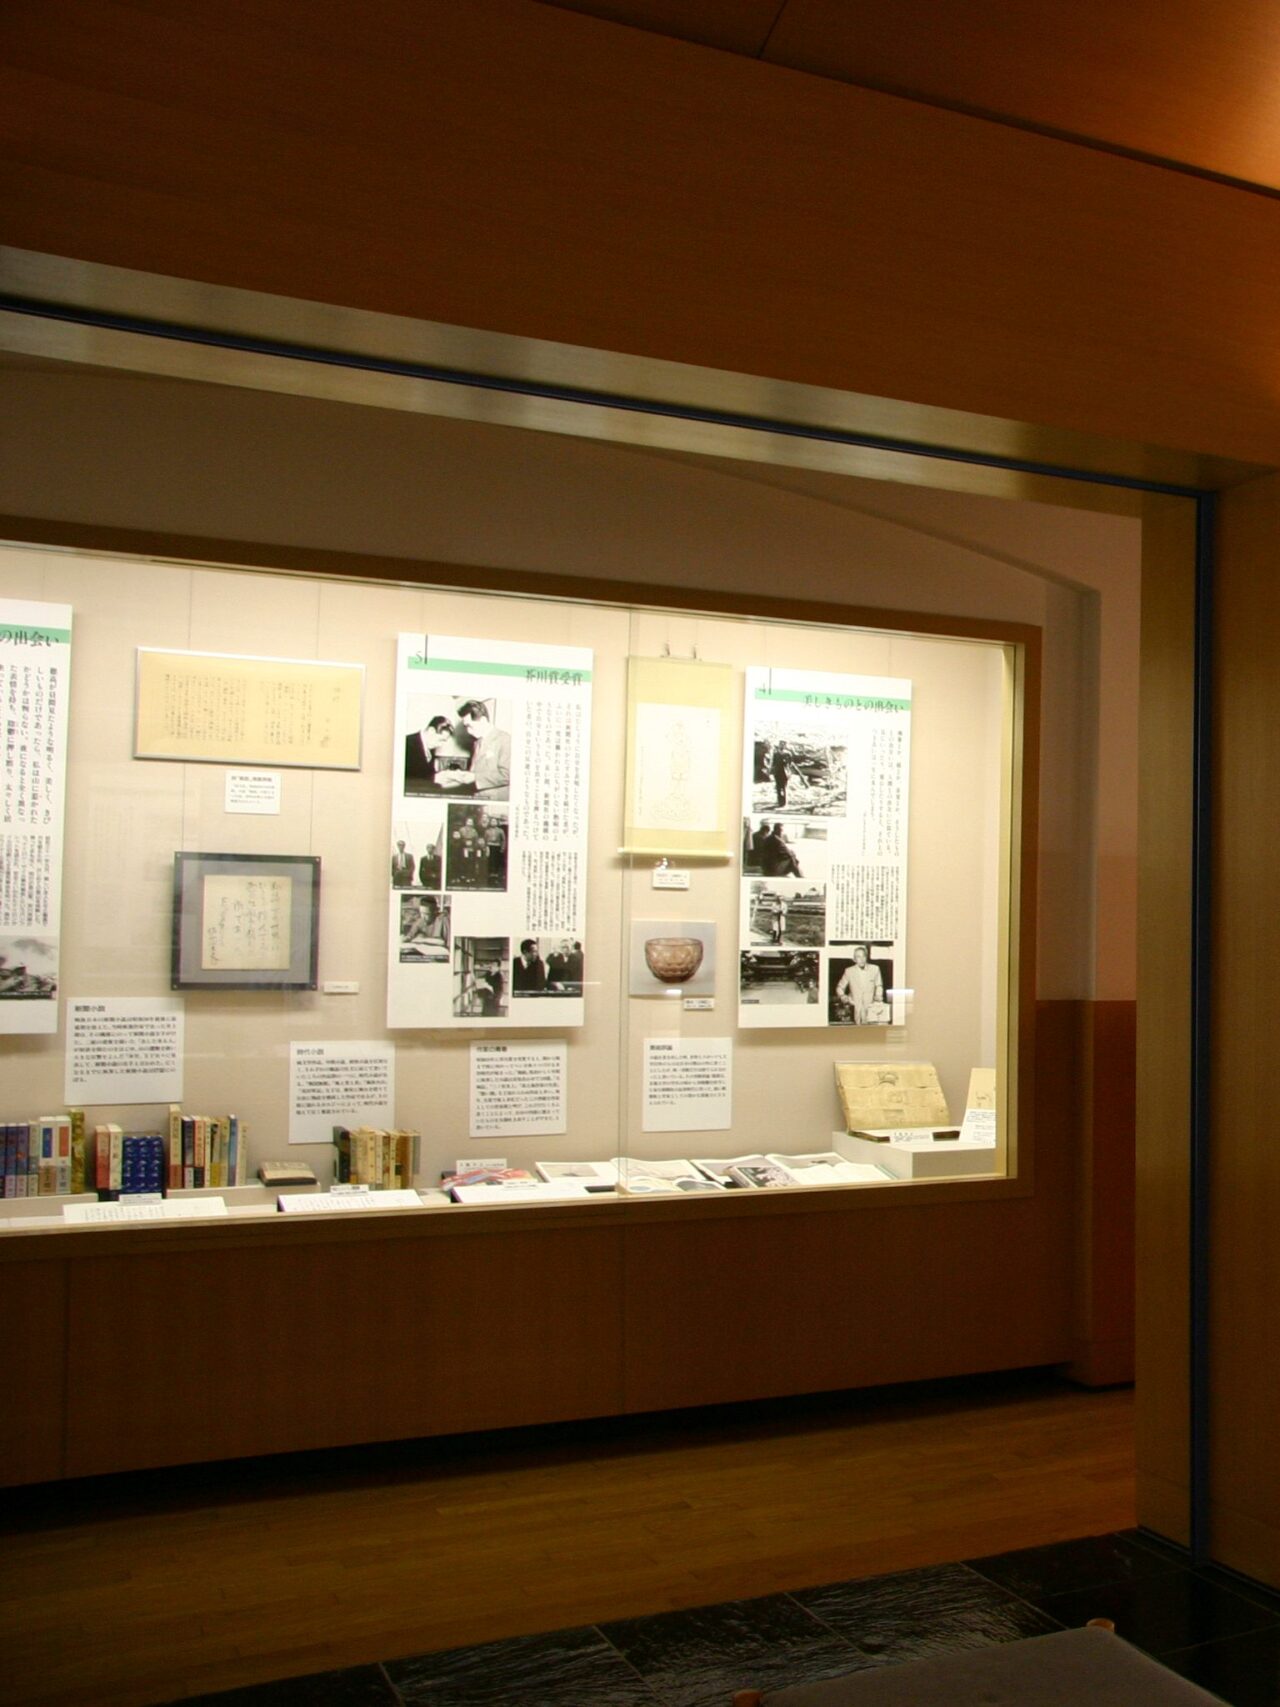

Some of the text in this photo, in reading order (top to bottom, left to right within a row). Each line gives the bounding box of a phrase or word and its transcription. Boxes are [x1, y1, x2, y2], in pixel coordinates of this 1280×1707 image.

[526, 668, 583, 687] 芥川賞受賞
